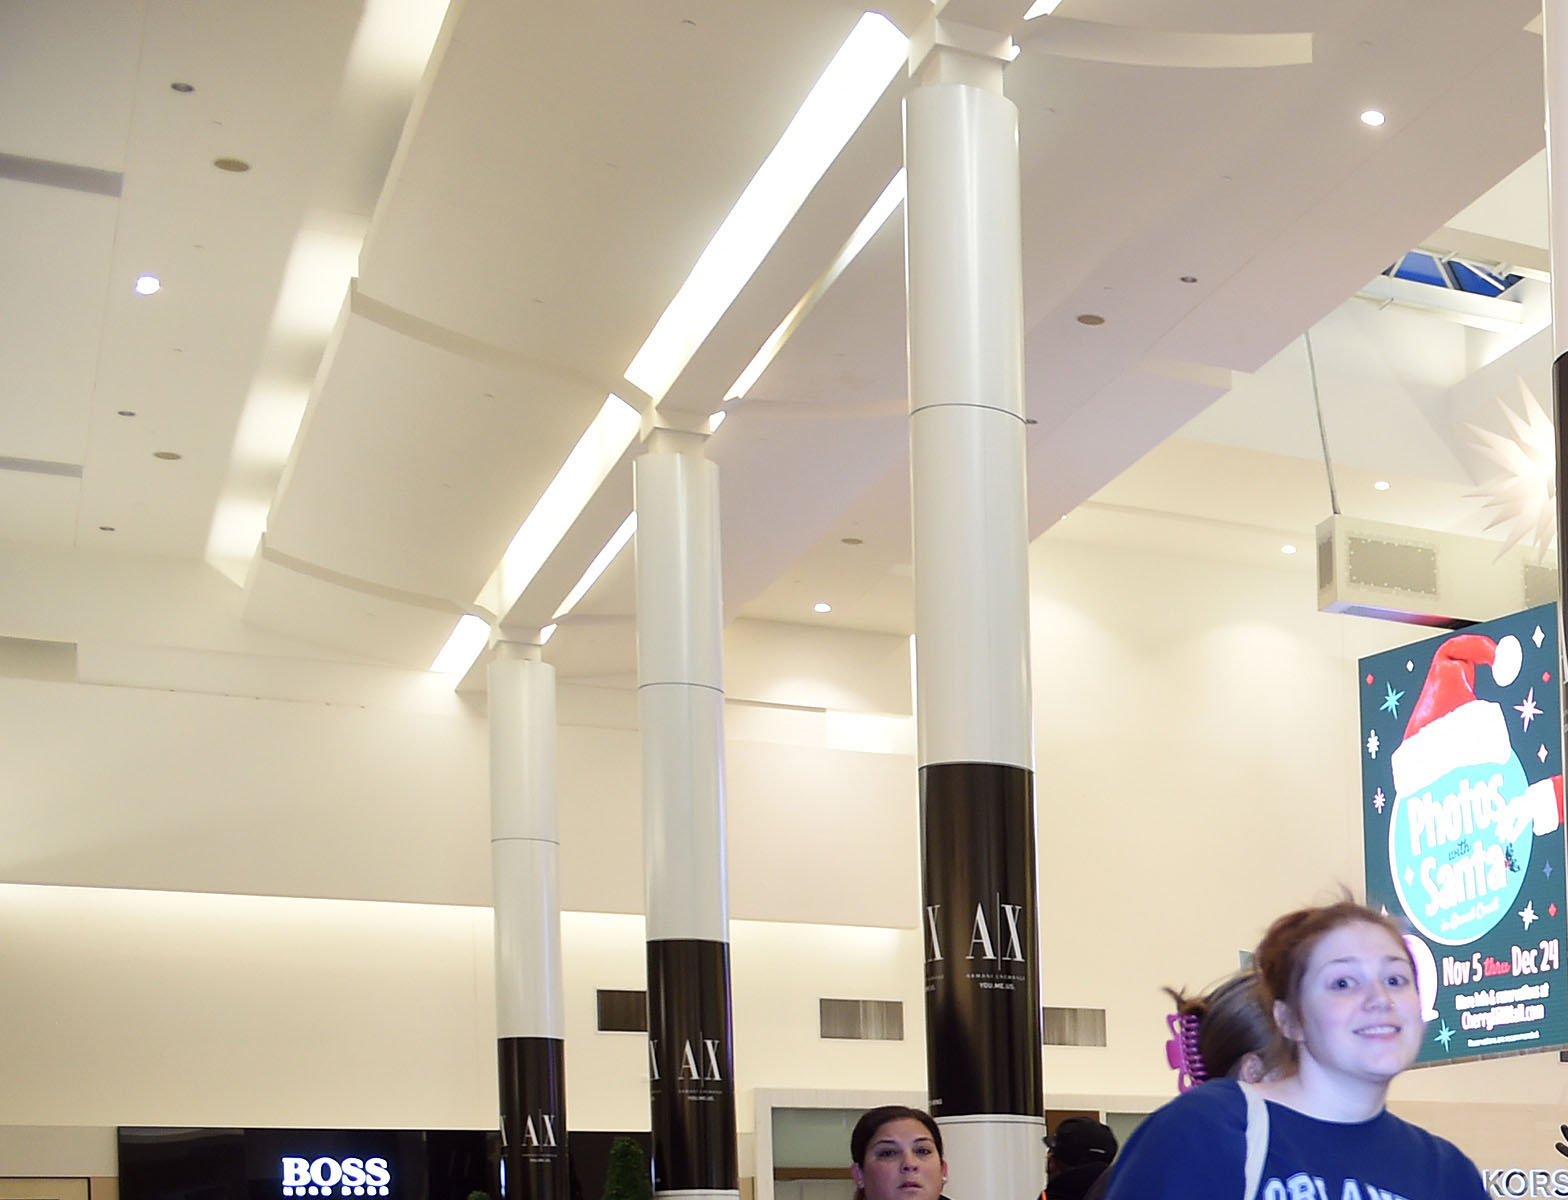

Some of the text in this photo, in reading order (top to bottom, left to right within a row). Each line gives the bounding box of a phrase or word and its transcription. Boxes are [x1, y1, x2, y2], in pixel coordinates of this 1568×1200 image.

[1407, 773, 1507, 857] Photos
[1448, 838, 1471, 861] with
[1420, 840, 1507, 917] Santa
[1442, 955, 1471, 987] Nov
[1471, 951, 1483, 982] 5
[1511, 945, 1538, 977] Dec
[1539, 938, 1560, 972] 24
[281, 1156, 391, 1187] BOSS
